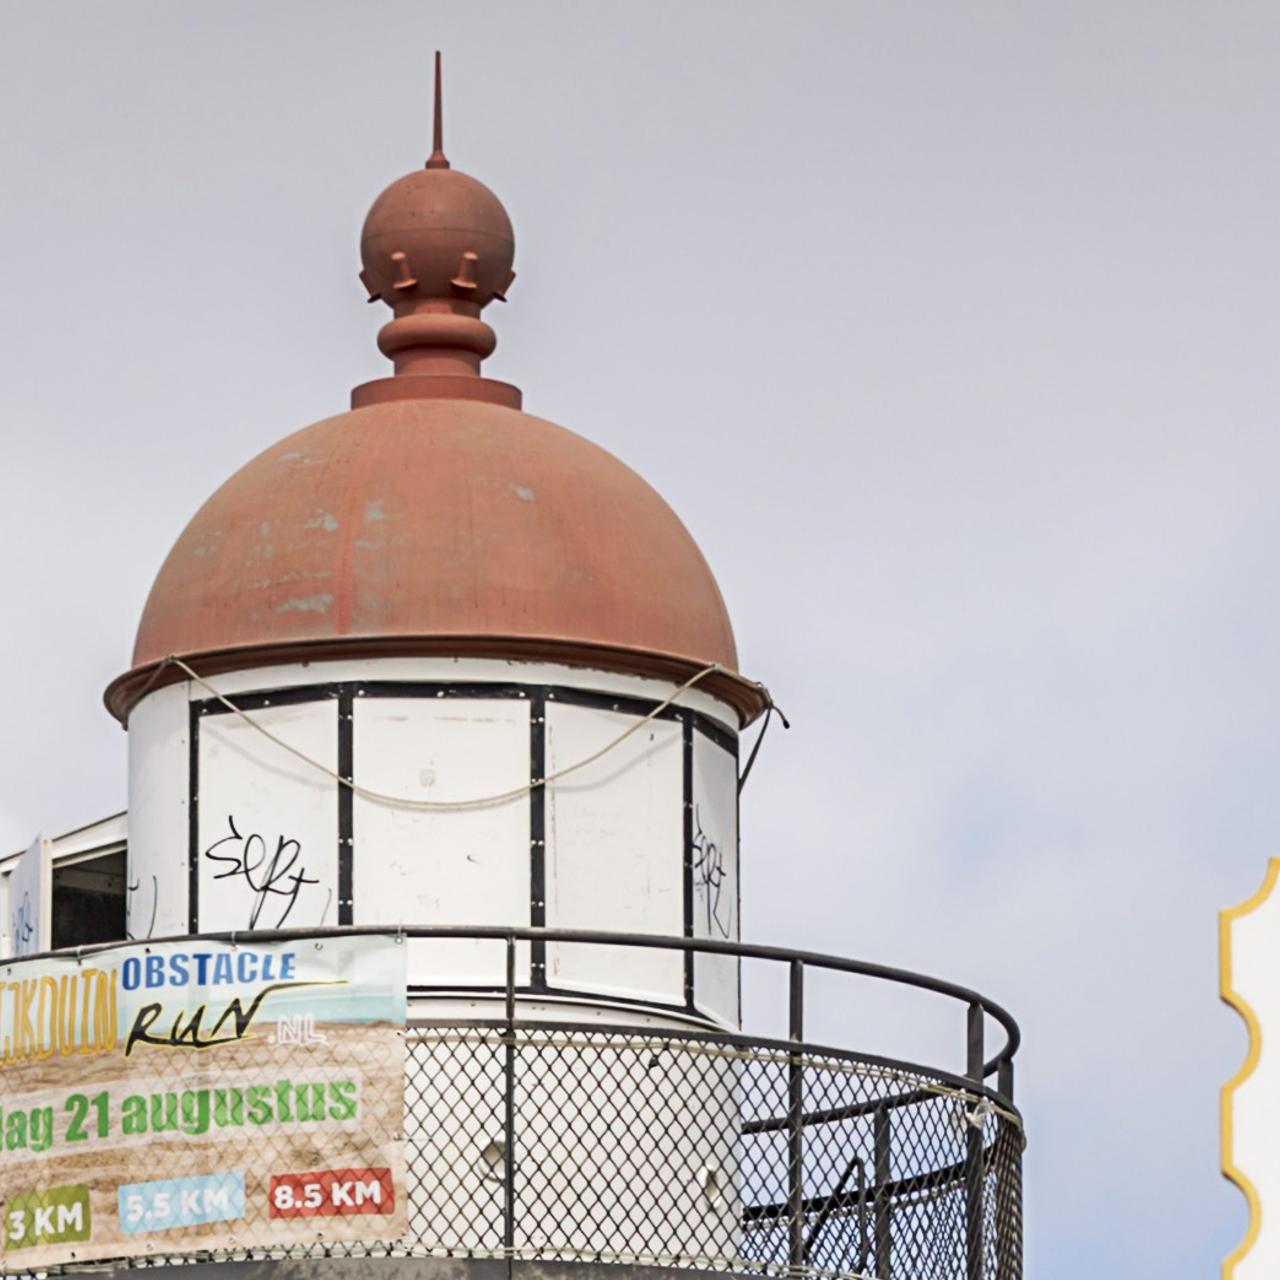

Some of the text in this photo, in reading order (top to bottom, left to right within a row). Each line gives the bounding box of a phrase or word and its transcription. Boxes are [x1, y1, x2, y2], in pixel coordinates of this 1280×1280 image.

[122, 951, 296, 991] OBSTACLE
[124, 979, 349, 1058] RUN
[64, 1090, 111, 1143] 21
[121, 1079, 358, 1136] augustus
[126, 1185, 231, 1222] 5.5 KM
[273, 1179, 382, 1210] 8.5 KM
[8, 1201, 84, 1241] 3 KM
